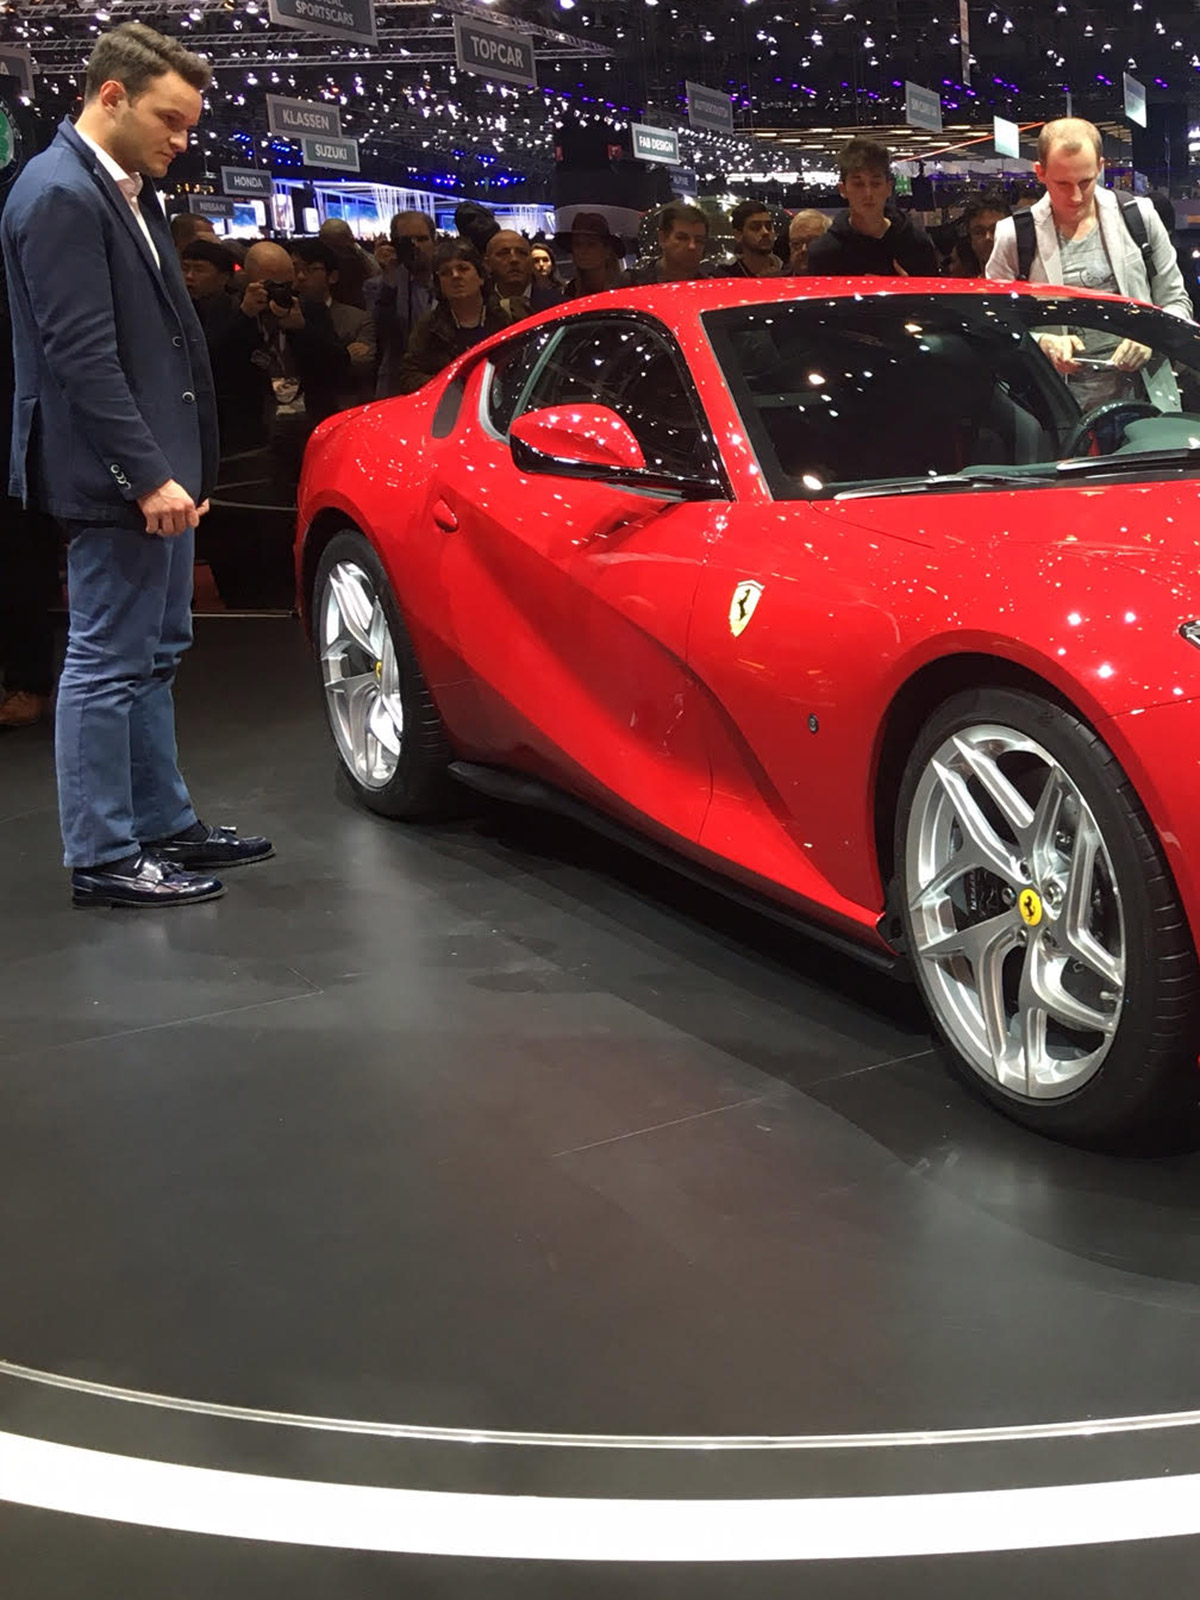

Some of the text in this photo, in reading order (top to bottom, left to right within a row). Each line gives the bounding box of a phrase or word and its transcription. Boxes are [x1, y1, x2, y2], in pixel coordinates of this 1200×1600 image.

[296, 1, 354, 26] SPORTSCARS
[470, 35, 524, 69] TOPCAR
[283, 109, 330, 130] KLASSEN
[315, 144, 348, 160] SUZUKI
[638, 135, 674, 153] FAB DESIGN
[234, 175, 263, 188] HONDA
